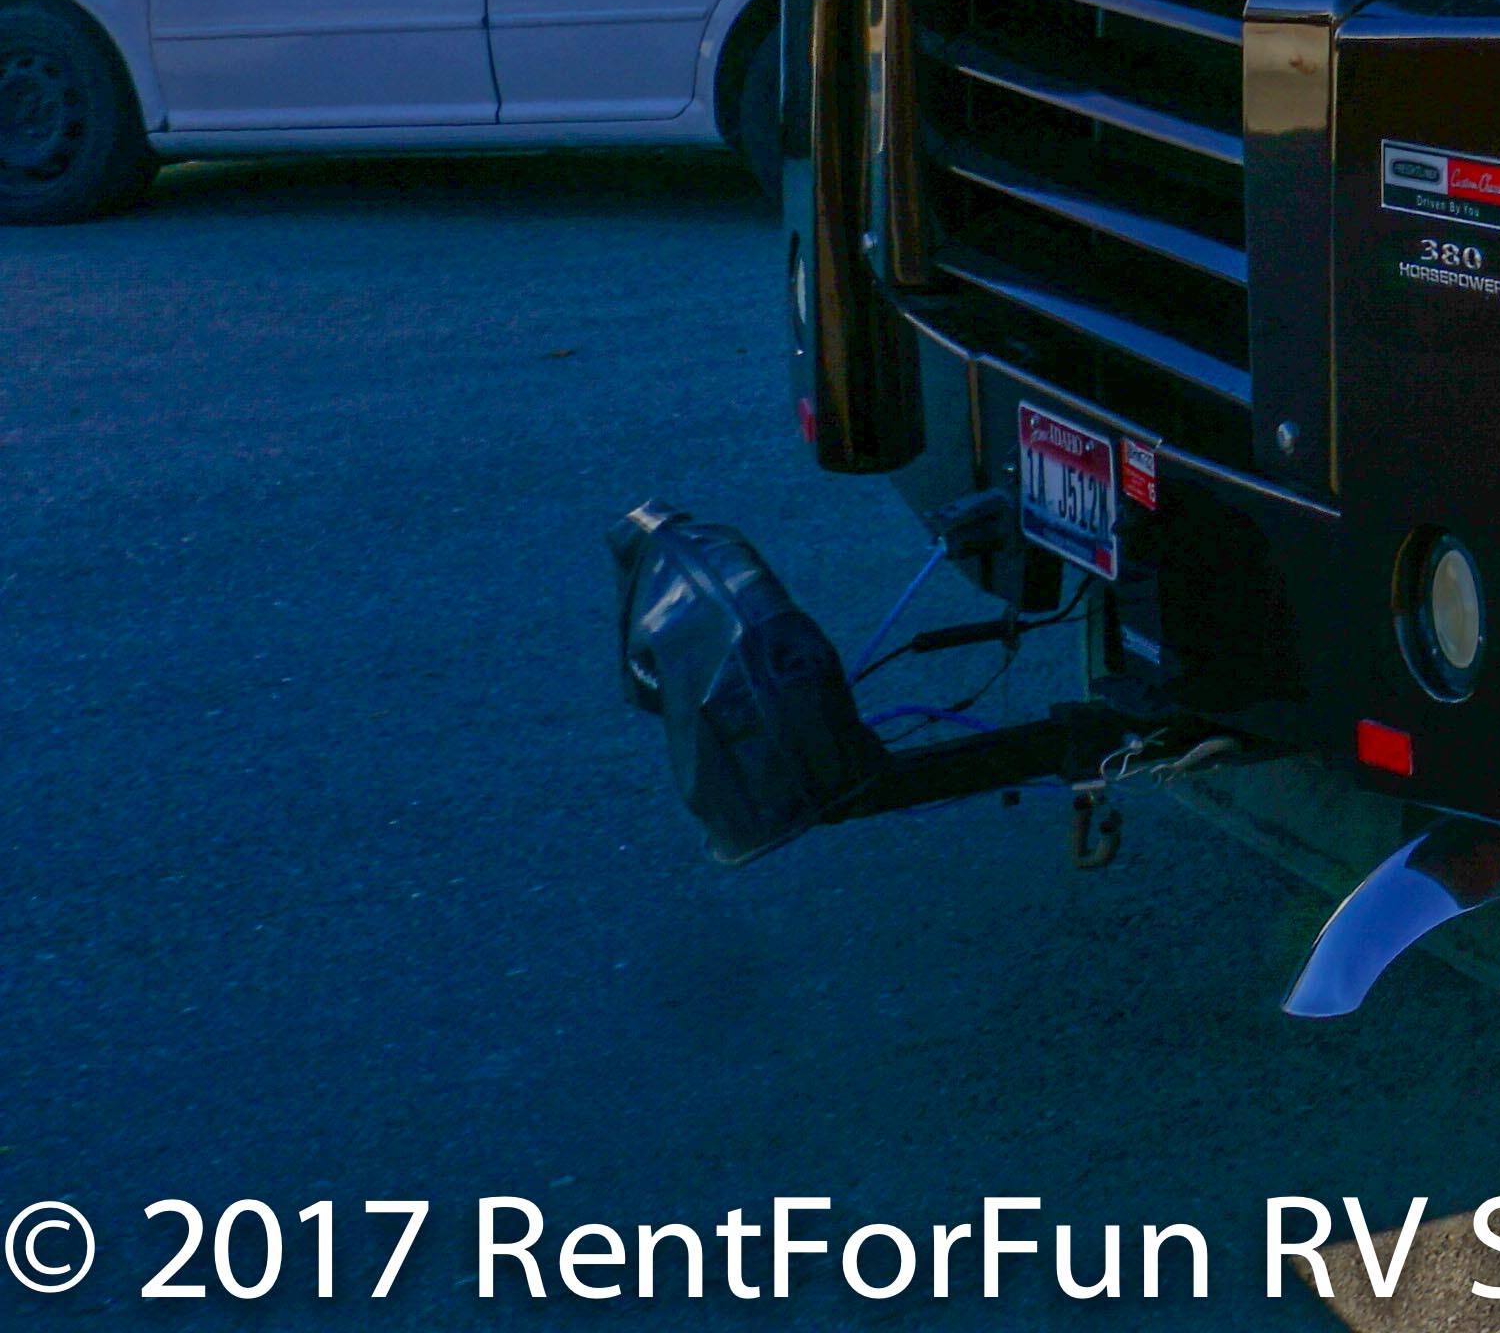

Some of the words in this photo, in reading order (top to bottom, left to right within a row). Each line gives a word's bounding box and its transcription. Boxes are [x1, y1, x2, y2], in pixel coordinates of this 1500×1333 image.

[1416, 194, 1446, 212] Driven
[1450, 201, 1460, 215] By
[1463, 205, 1480, 218] You
[1420, 239, 1482, 270] 380
